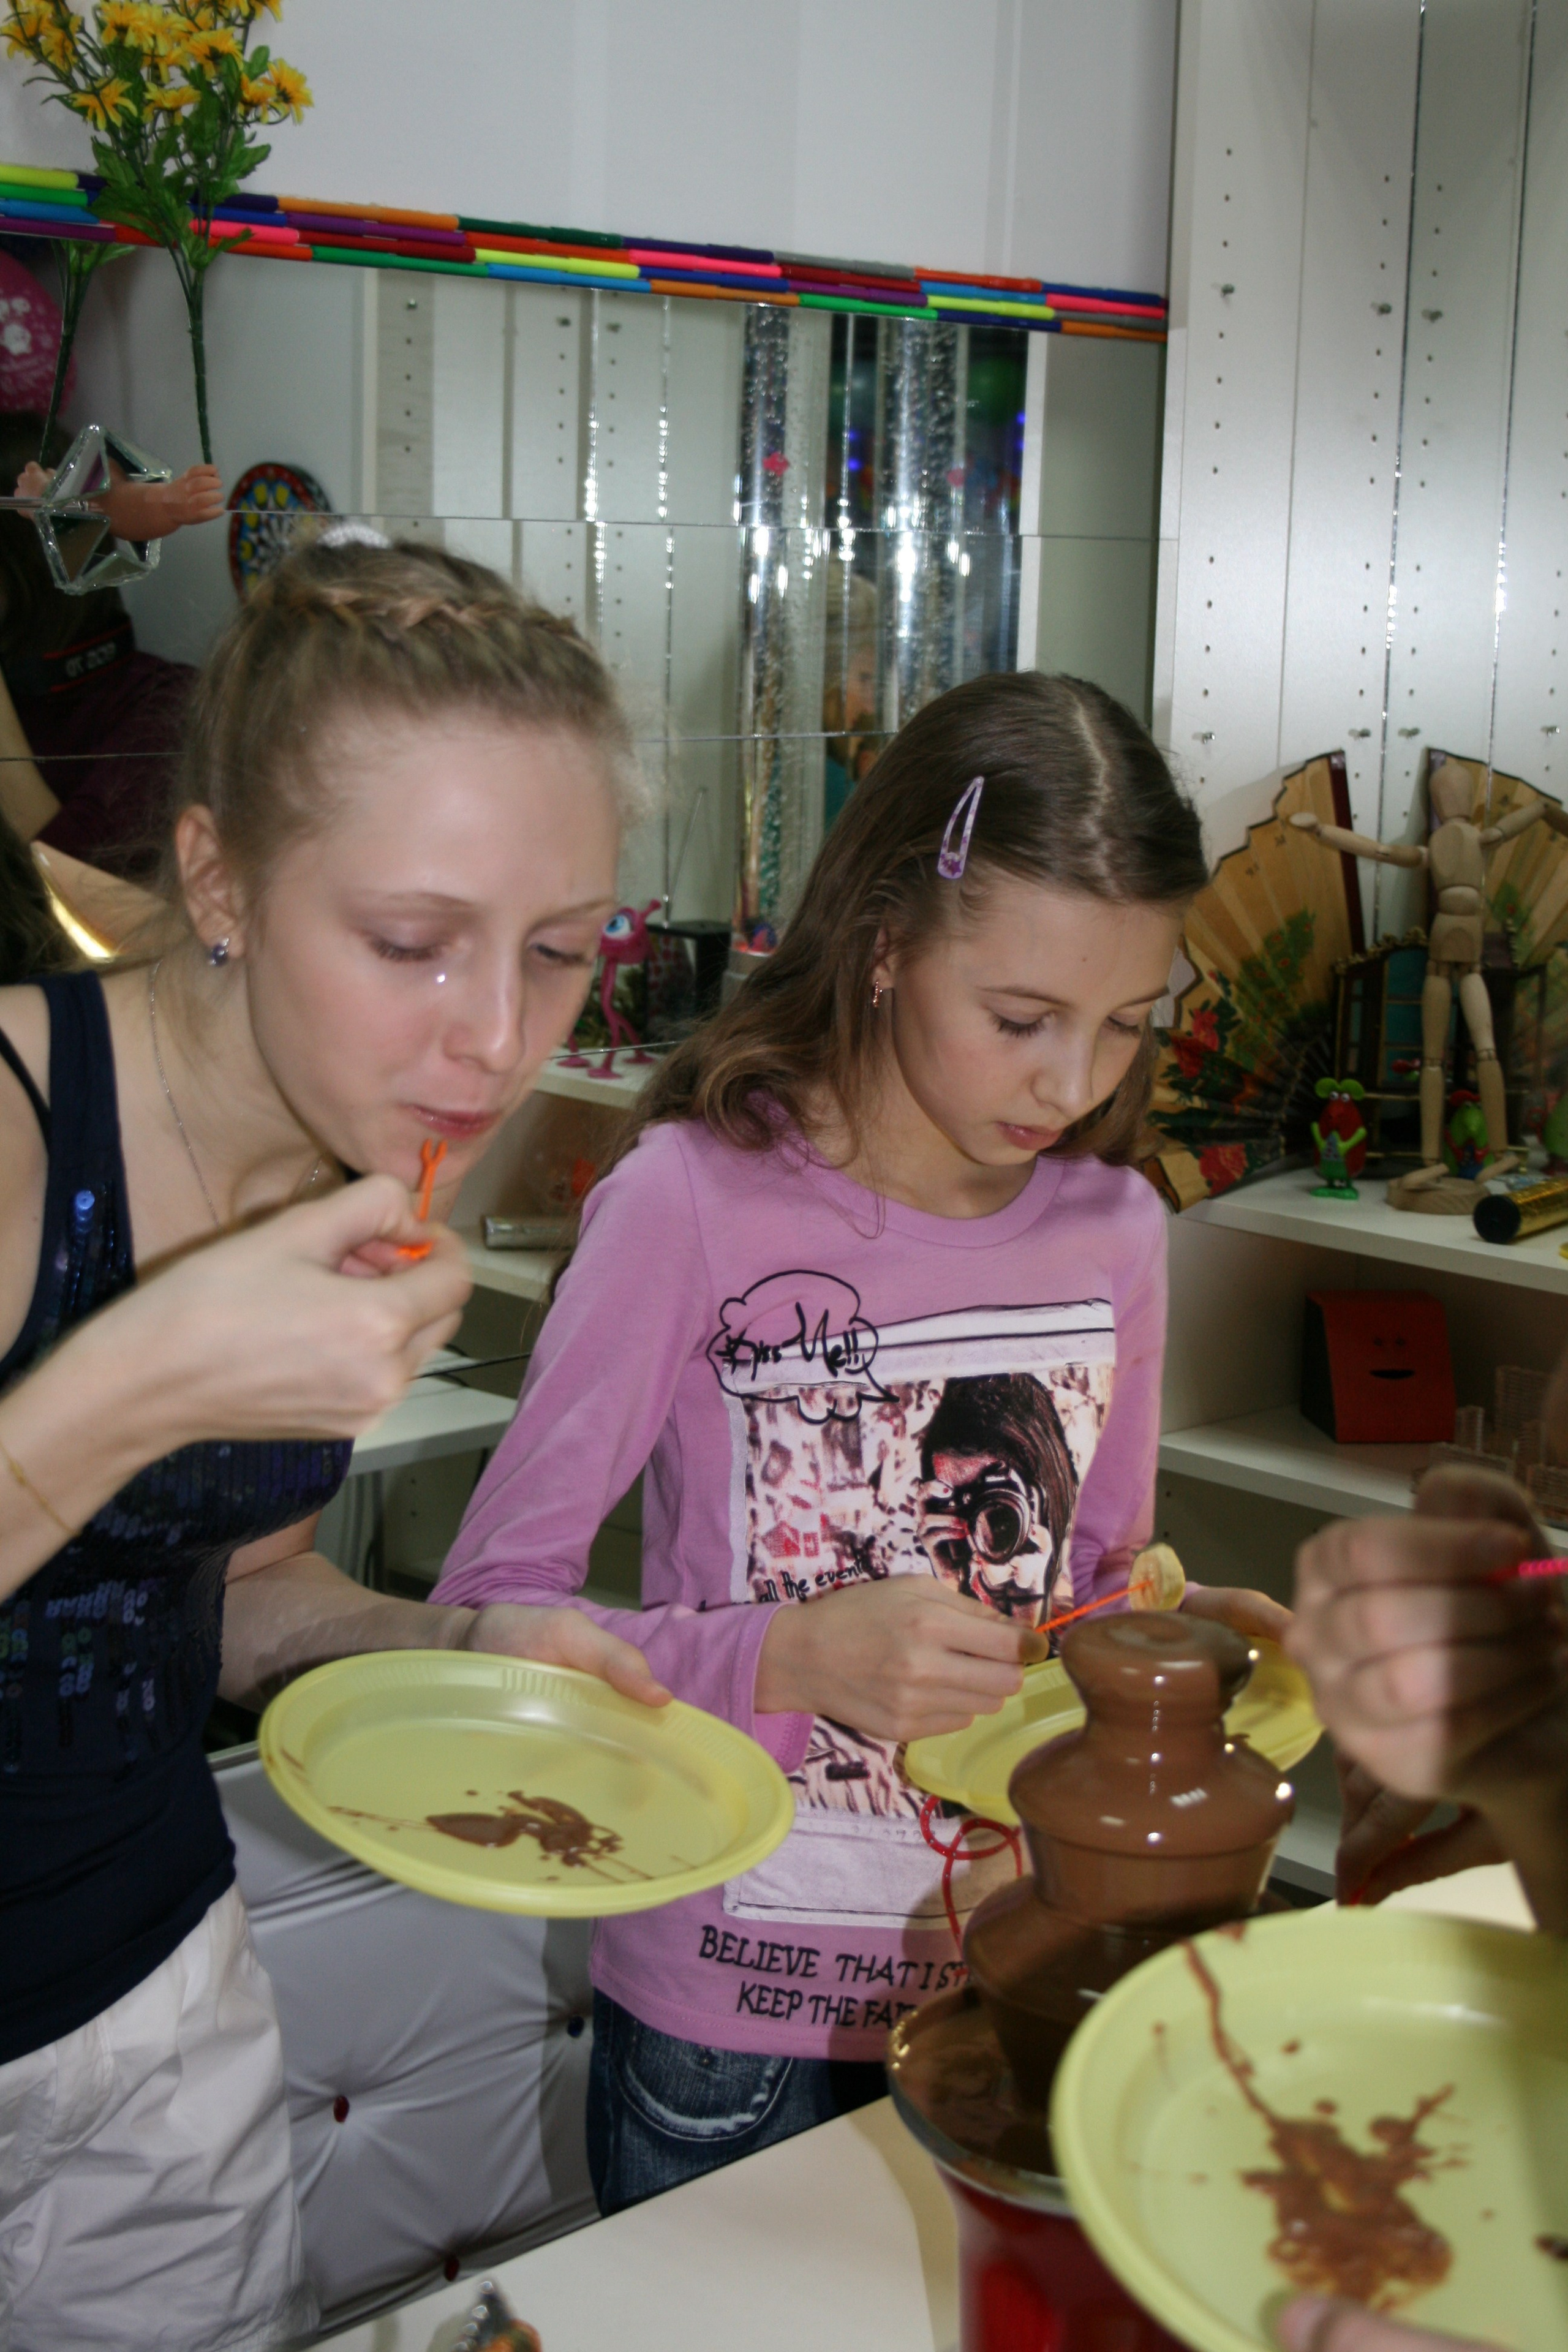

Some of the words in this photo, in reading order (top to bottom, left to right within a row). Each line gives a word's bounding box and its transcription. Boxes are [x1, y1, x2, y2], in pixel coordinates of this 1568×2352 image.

[780, 1570, 810, 1602] the
[699, 1924, 820, 1977] BELIEVE
[736, 1981, 802, 2019] KEEP
[808, 1994, 858, 2027] THE
